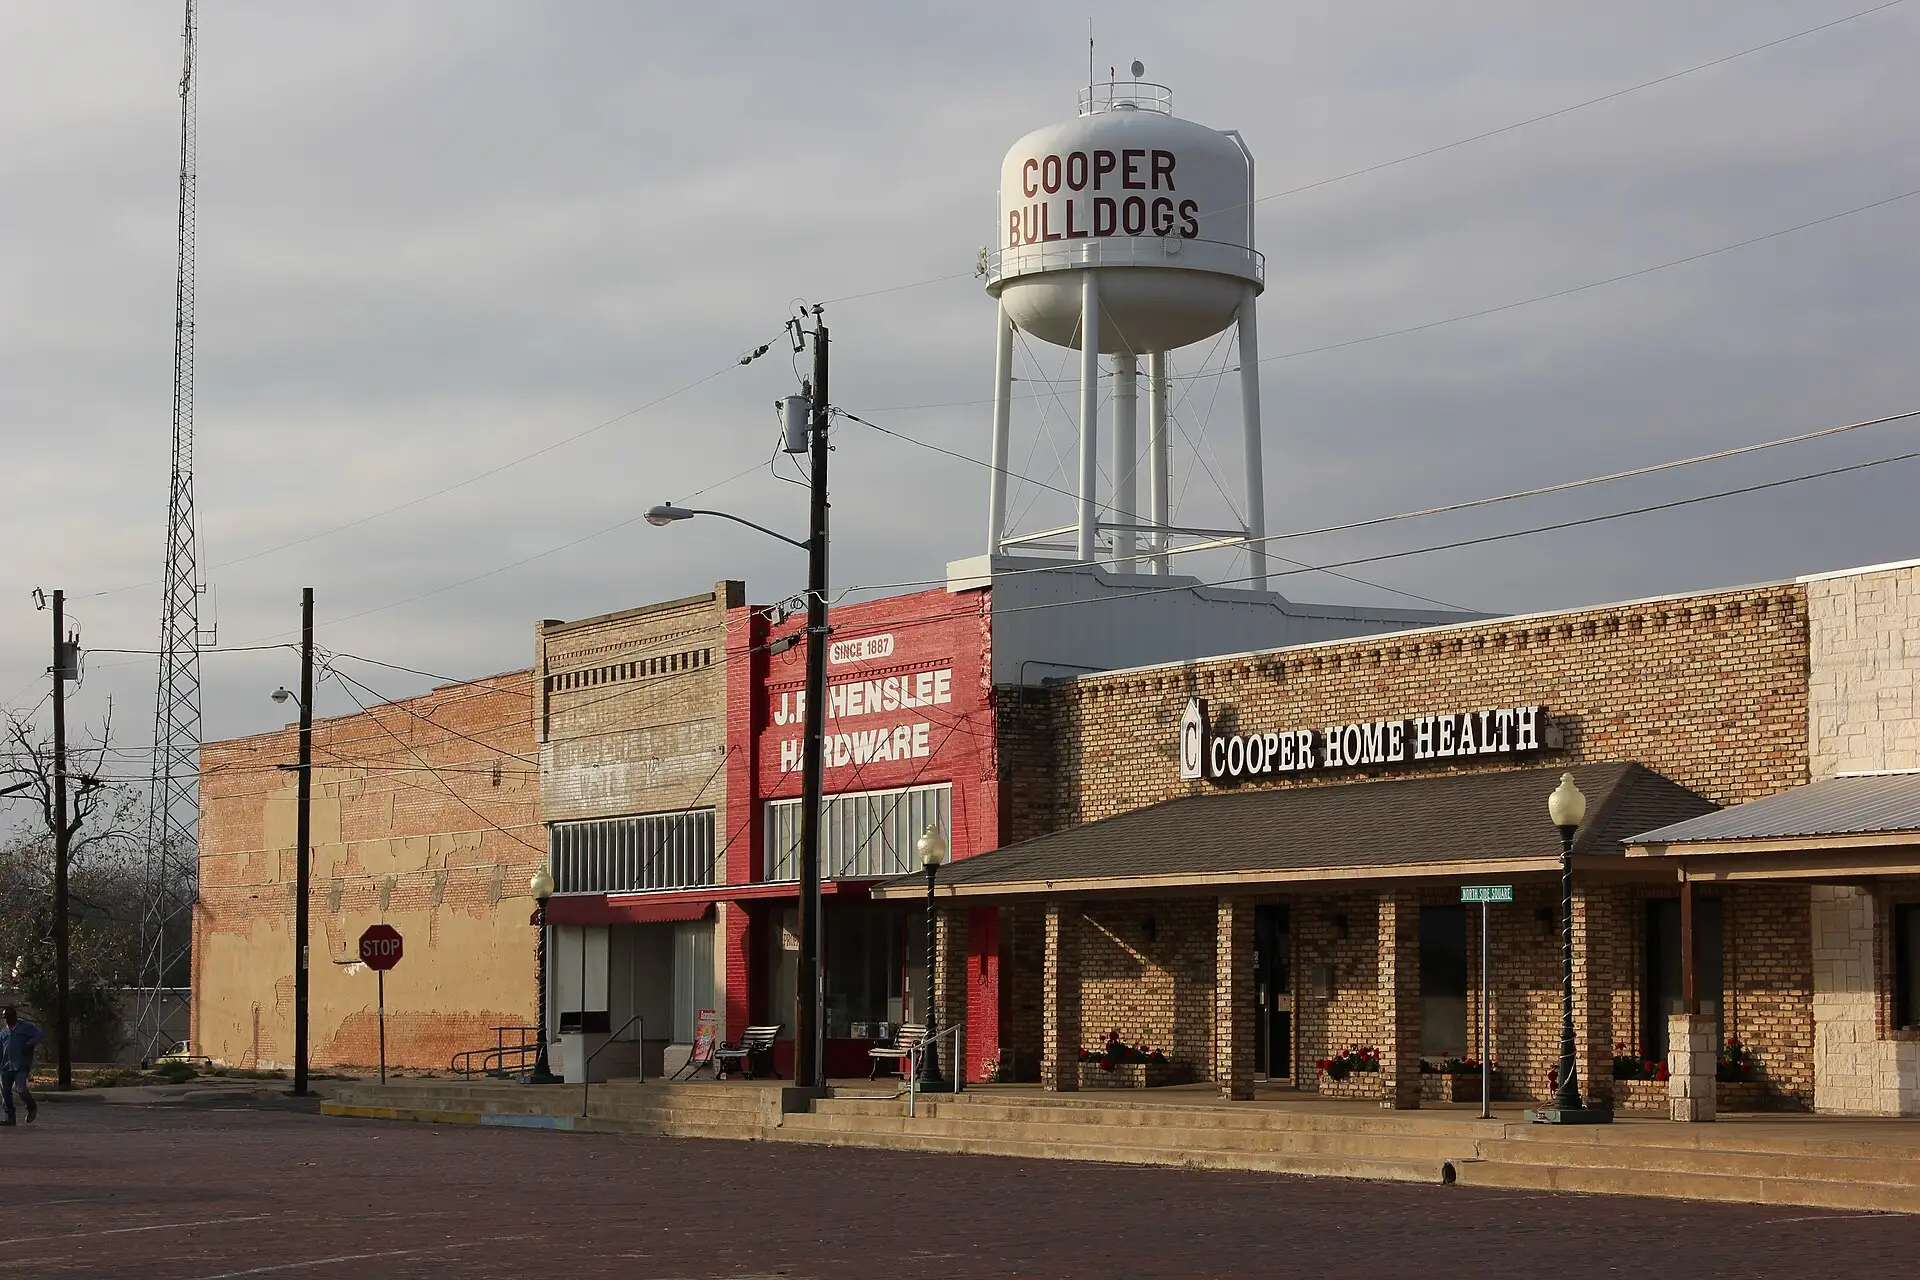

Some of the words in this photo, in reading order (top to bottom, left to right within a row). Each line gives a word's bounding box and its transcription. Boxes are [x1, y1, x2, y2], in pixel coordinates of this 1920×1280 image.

[1022, 149, 1176, 198] COOPER
[1009, 195, 1199, 249] BULLDOGS
[834, 642, 863, 661] SINCE
[866, 638, 890, 656] 1887
[829, 668, 952, 719] HENSLEE
[1211, 729, 1315, 778] COOPER
[1323, 720, 1404, 767] HOME
[1414, 706, 1539, 760] HEALTH
[1462, 888, 1478, 900] NORTH
[1479, 888, 1490, 900] SIDE
[1491, 888, 1511, 899] SQUARE
[362, 939, 400, 957] STOP
